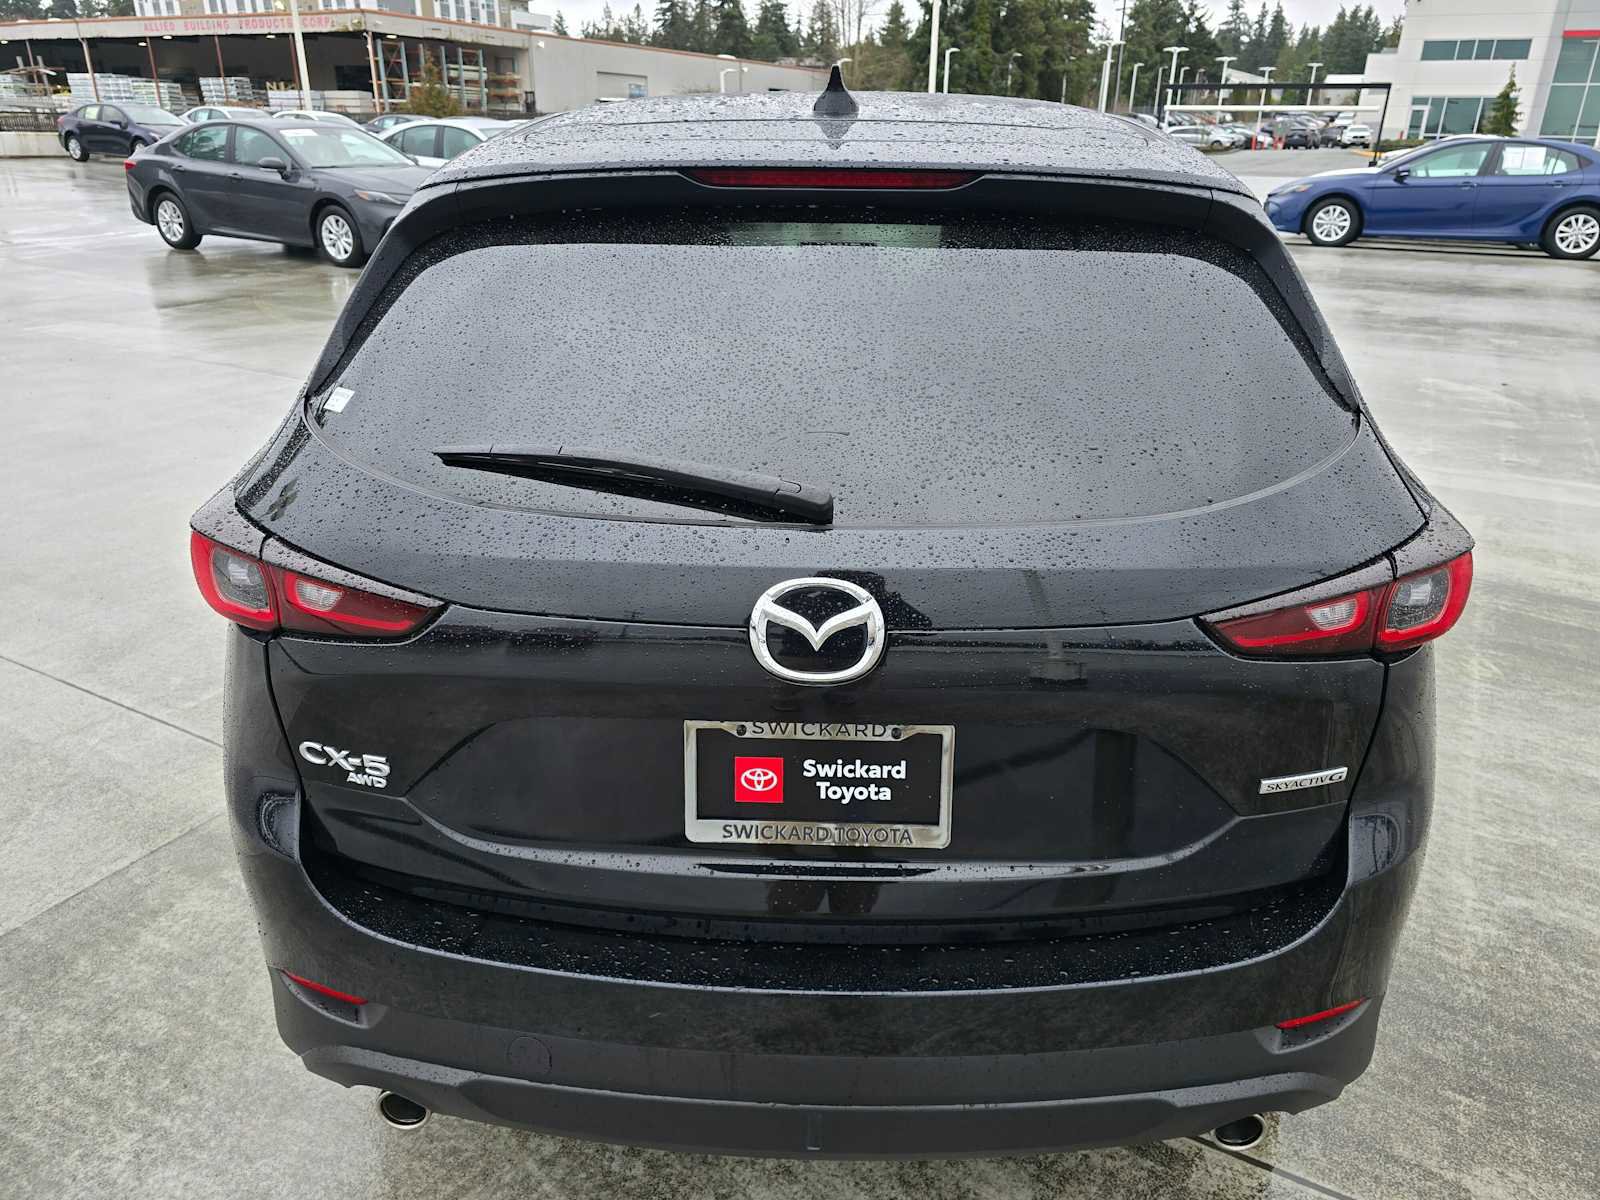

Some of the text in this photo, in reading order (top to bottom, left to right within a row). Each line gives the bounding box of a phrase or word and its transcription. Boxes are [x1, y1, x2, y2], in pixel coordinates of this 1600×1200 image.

[143, 22, 176, 33] ALLIED
[184, 19, 230, 31] BUILDING
[239, 17, 293, 30] PRODUCTS
[751, 721, 887, 738] SWICKARD
[298, 740, 391, 777] CX-5
[802, 758, 907, 780] Swickard
[346, 771, 388, 789] AWD
[815, 781, 892, 805] Toyota
[721, 823, 913, 845] SWICKARD TOYOTA
